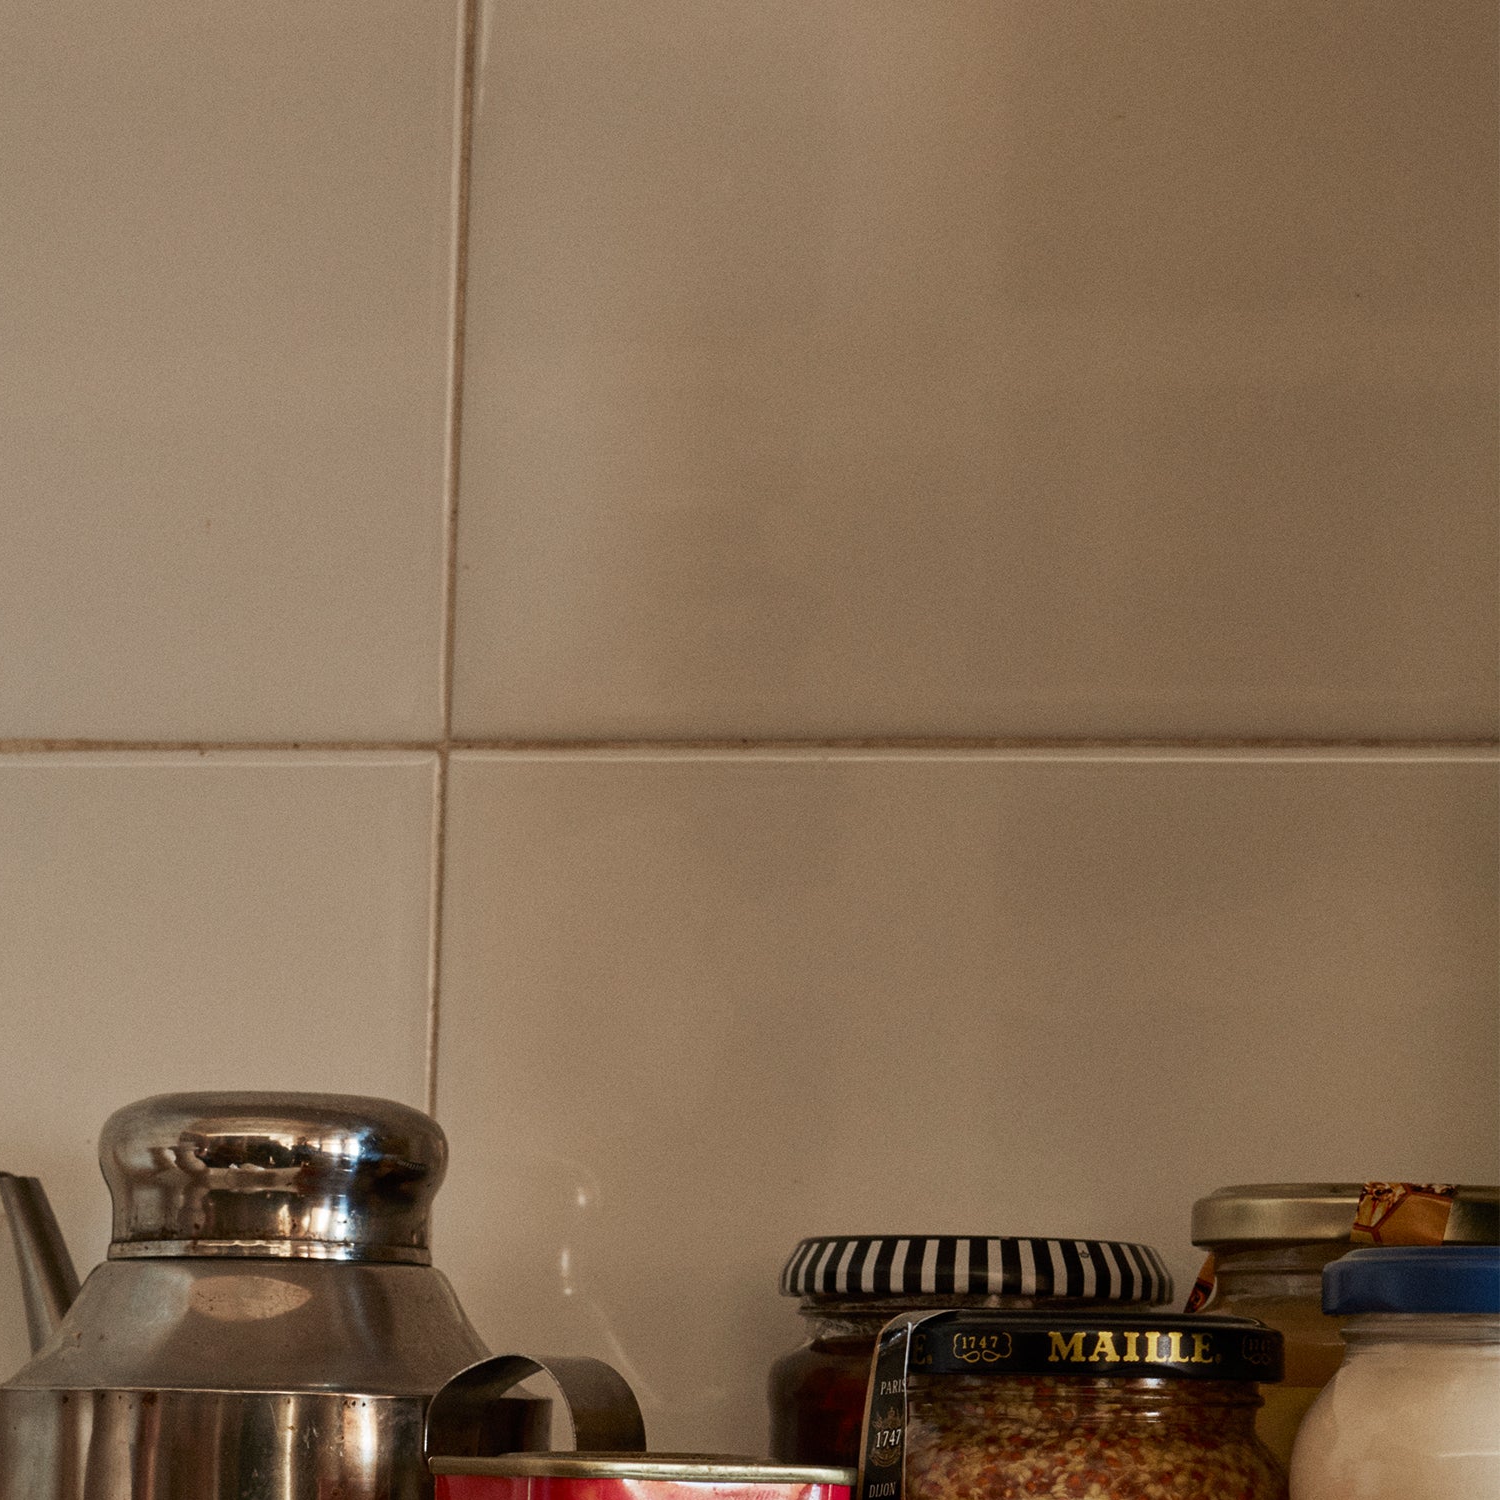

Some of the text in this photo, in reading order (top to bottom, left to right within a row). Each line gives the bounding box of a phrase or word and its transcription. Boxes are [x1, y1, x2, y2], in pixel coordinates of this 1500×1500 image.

[962, 1336, 999, 1350] 1747
[1048, 1331, 1213, 1363] MAILLE
[875, 1428, 902, 1449] 1747
[868, 1480, 897, 1499] DIJON
